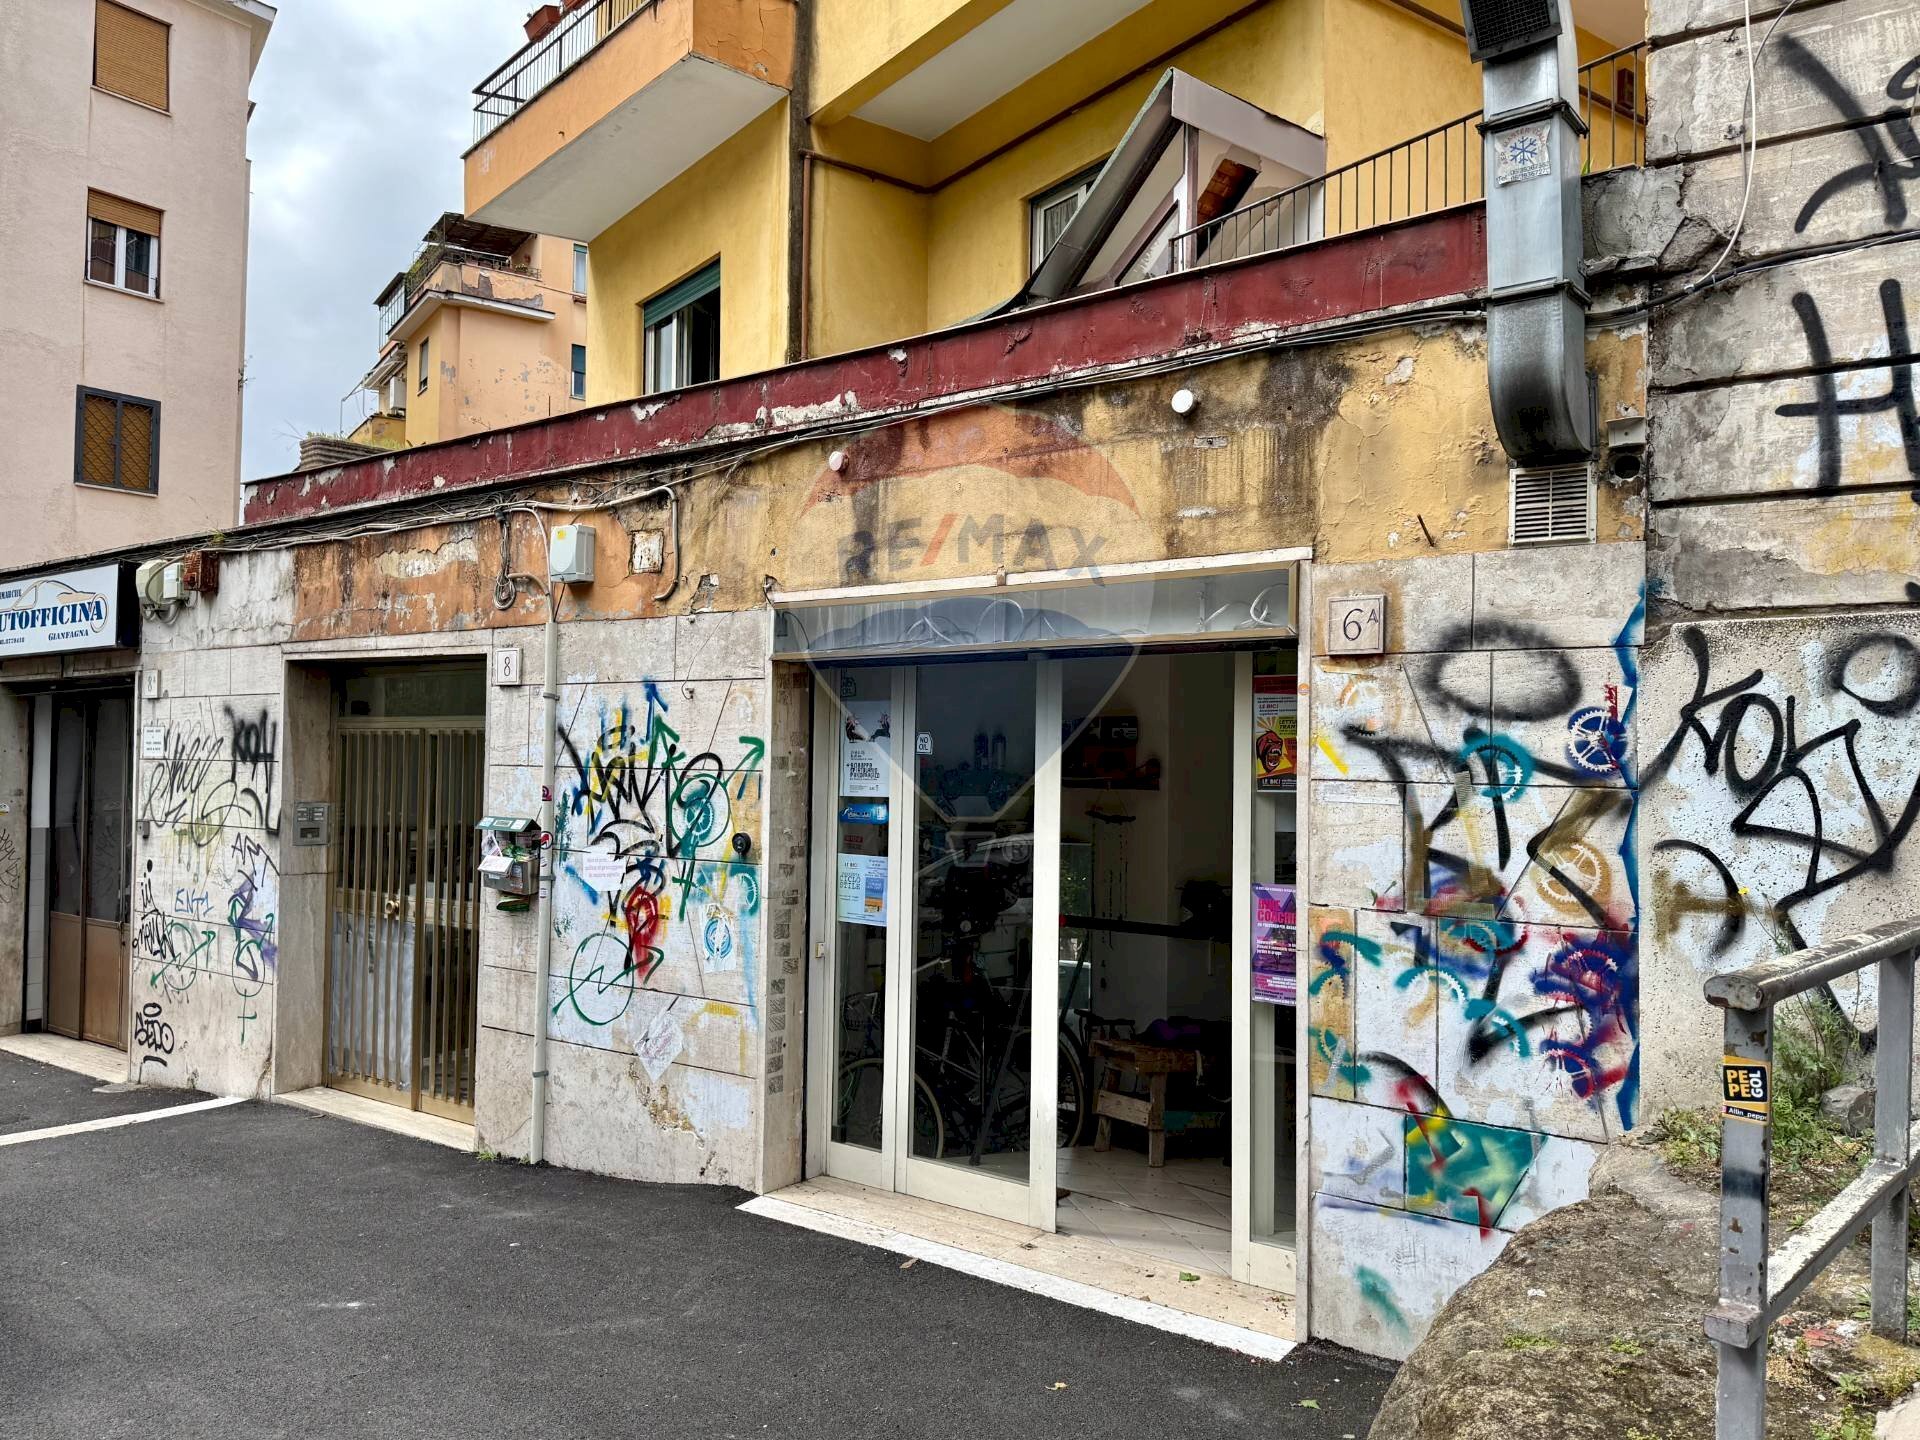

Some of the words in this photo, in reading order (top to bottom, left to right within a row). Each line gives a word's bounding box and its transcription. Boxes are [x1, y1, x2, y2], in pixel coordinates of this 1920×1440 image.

[48, 629, 89, 641] GIANFAGNA
[503, 656, 511, 677] 8
[1749, 1070, 1763, 1098] GOL
